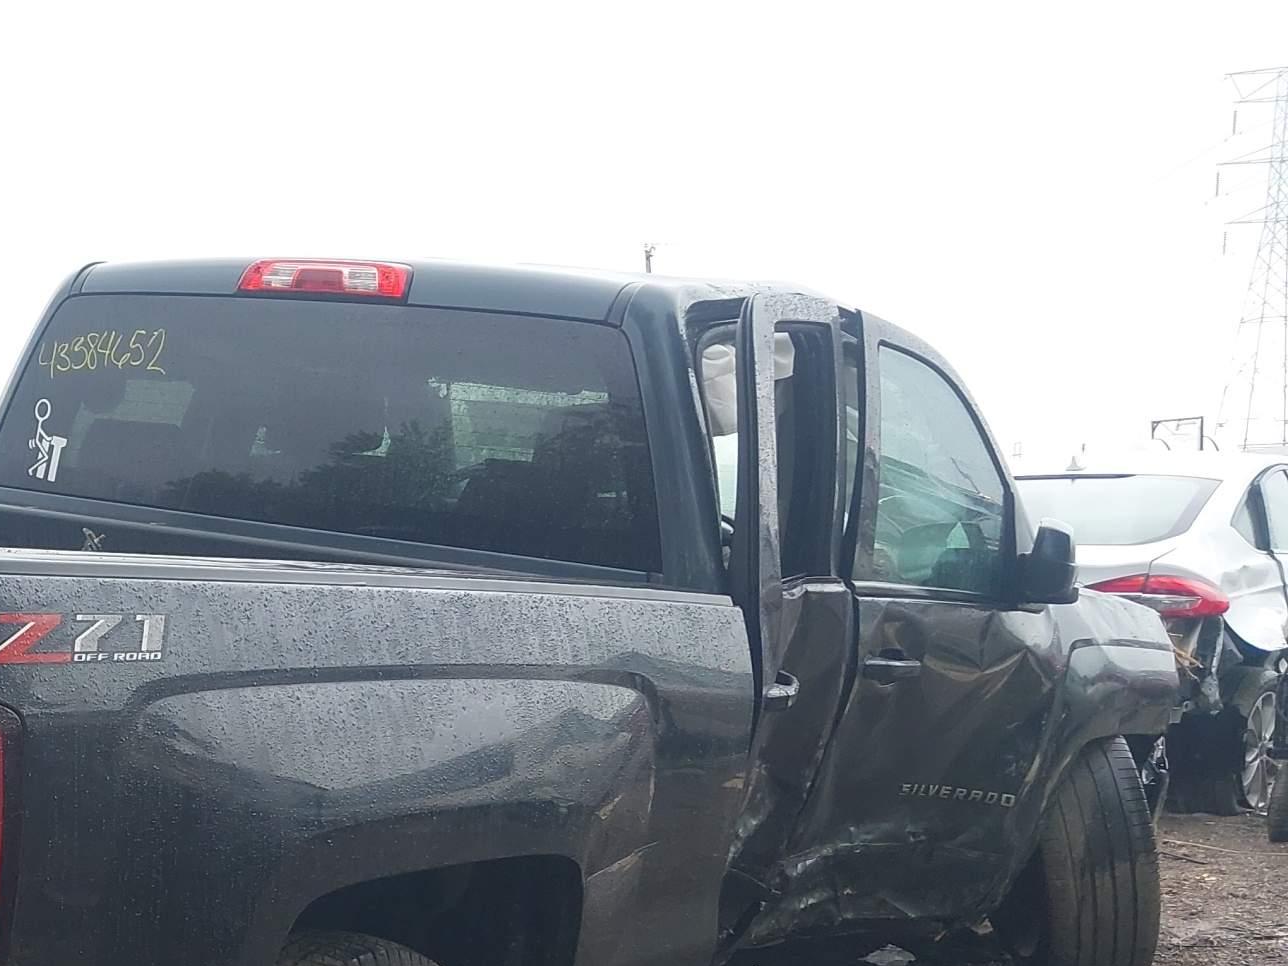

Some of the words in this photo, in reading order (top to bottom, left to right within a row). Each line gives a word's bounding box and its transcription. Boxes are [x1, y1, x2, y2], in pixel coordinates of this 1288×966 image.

[39, 328, 166, 379] 43384652
[74, 652, 109, 662] OFF
[113, 652, 162, 662] ROAD
[899, 783, 1016, 807] SILVERADO
